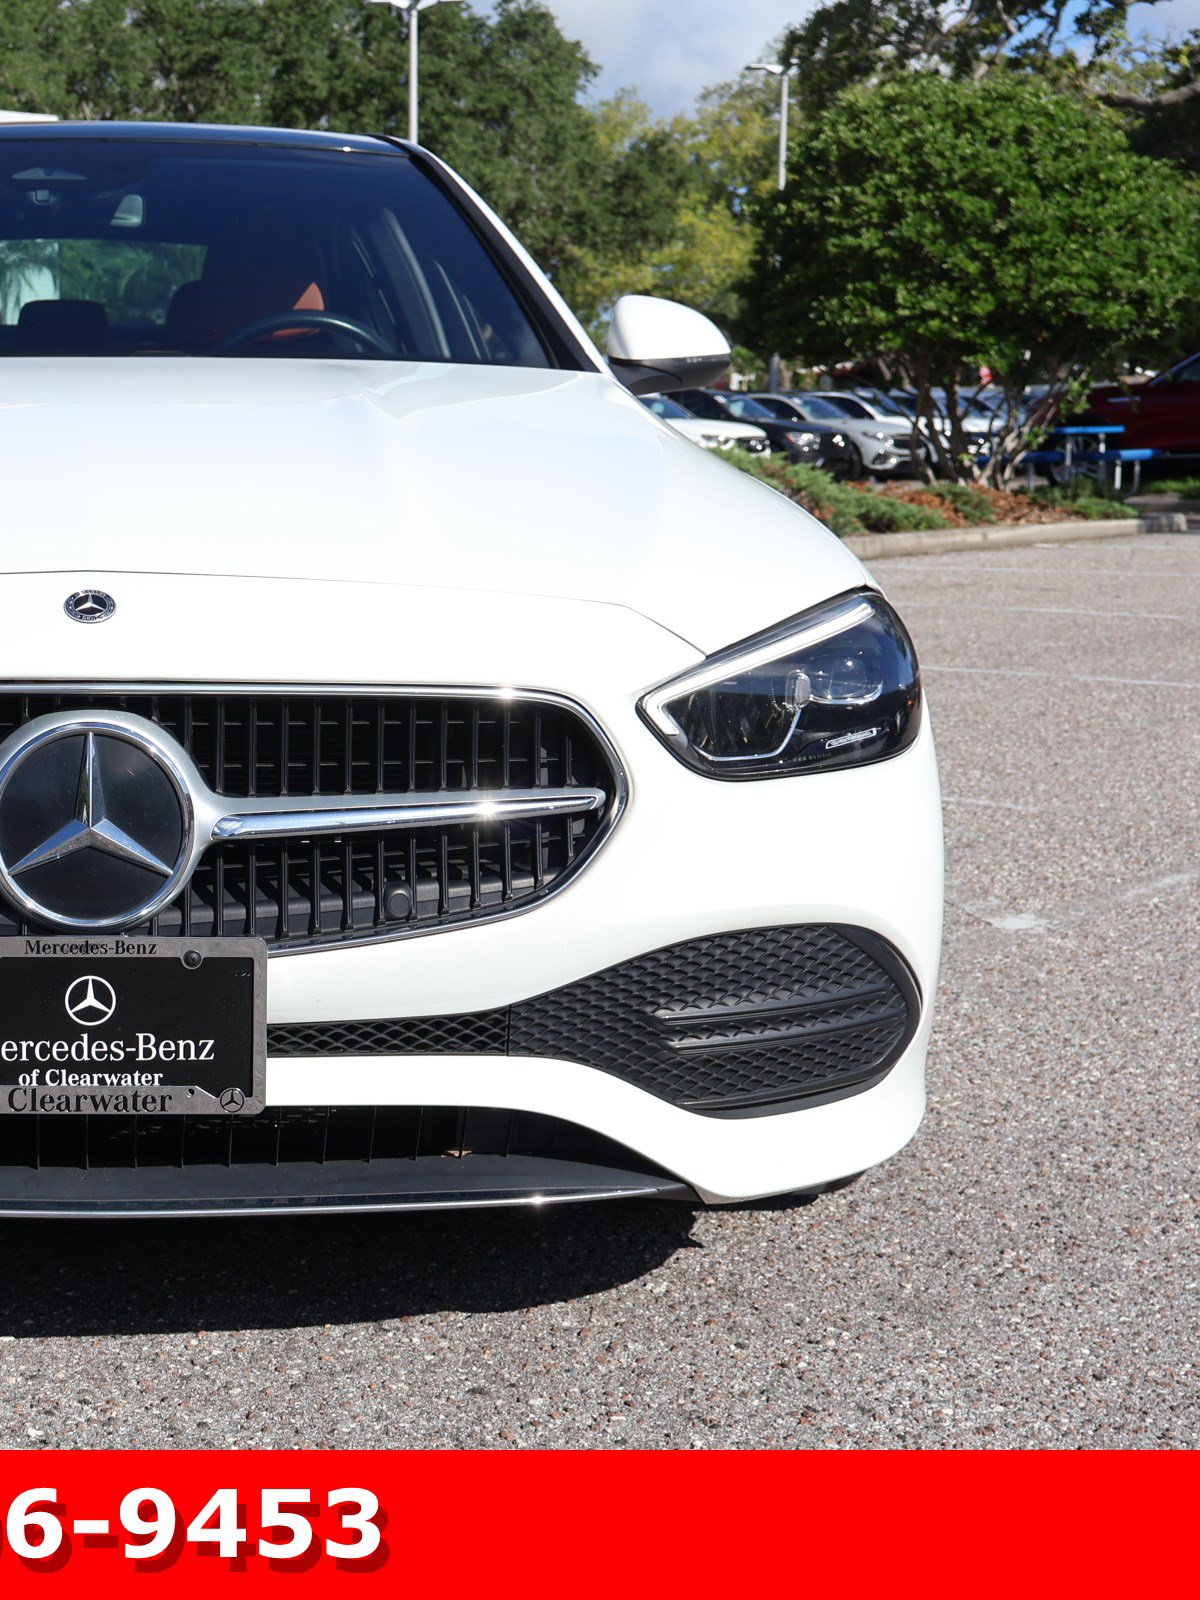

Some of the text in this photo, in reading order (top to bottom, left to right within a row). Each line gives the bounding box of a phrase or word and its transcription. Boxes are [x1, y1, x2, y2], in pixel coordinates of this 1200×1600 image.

[24, 939, 157, 955] Mercedes-Benz
[18, 1068, 164, 1087] of Clearwater
[7, 1087, 173, 1112] Clearwater
